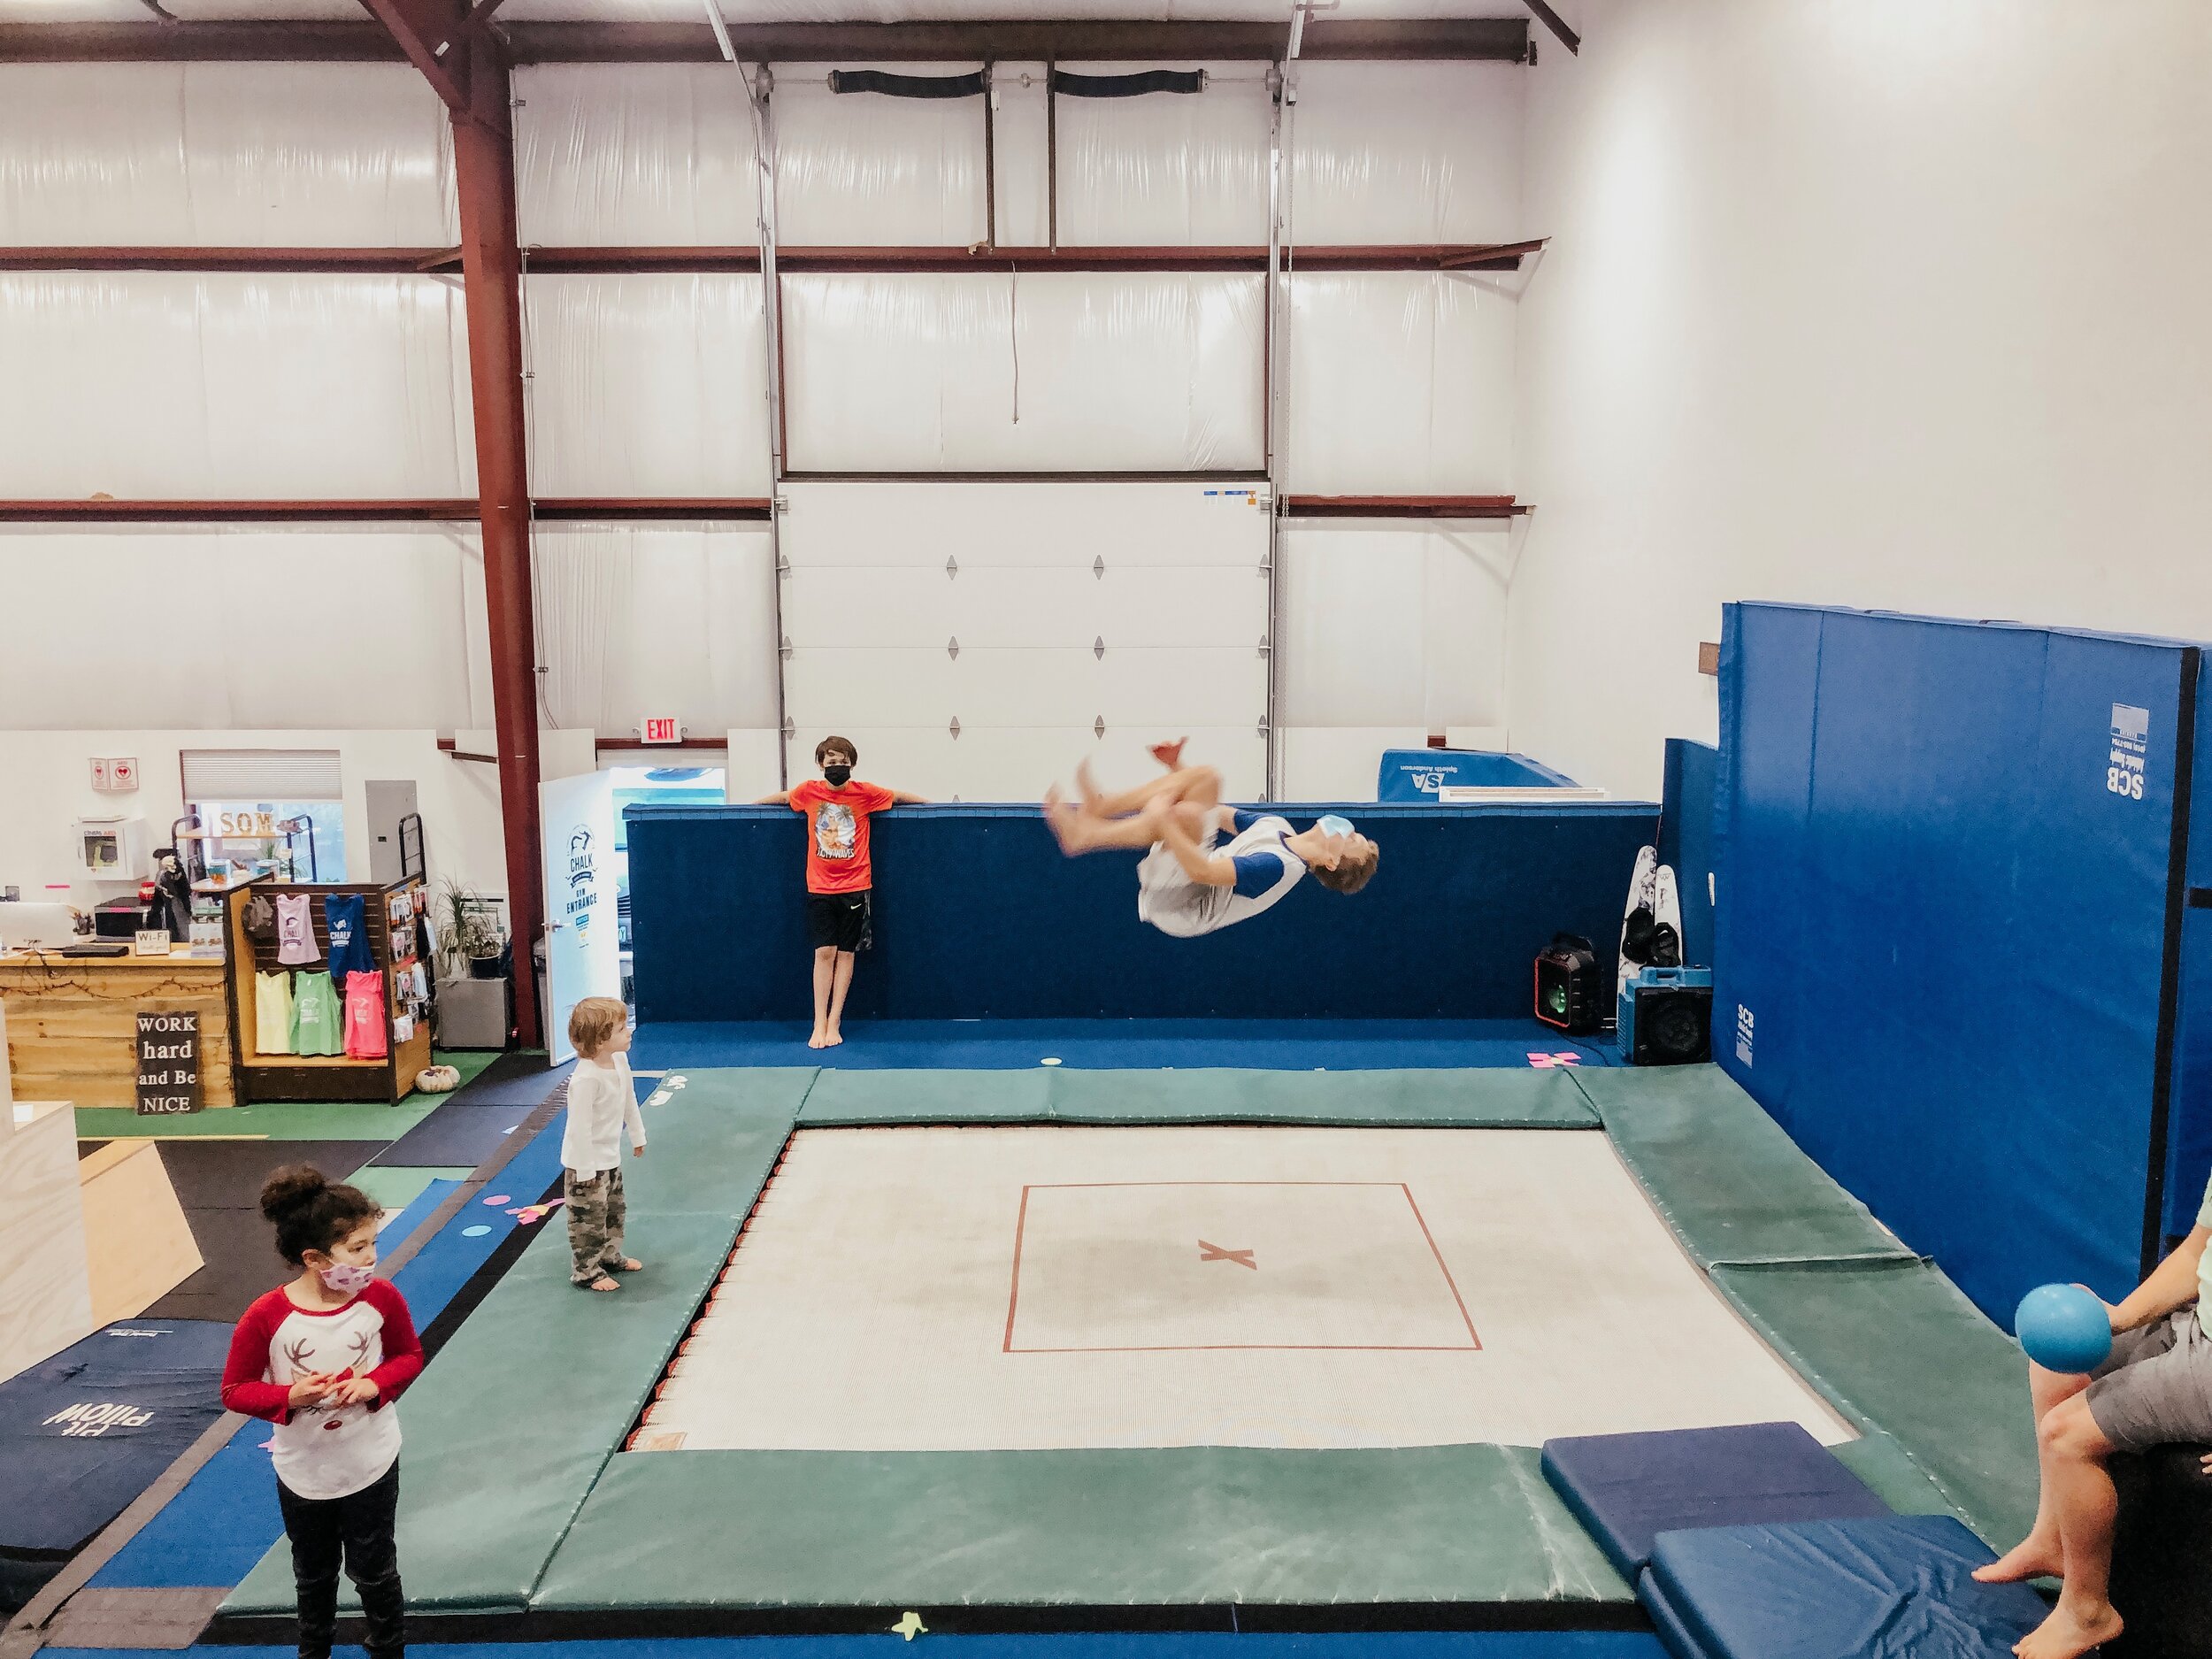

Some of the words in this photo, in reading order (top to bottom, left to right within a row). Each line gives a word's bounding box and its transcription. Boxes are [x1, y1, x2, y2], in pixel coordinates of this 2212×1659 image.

[647, 718, 674, 740] EXIT
[1411, 773, 1442, 791] SA
[2107, 767, 2144, 800] SCB
[219, 812, 273, 833] SOM
[570, 853, 594, 872] CHALK
[566, 893, 597, 915] ENTRANCE
[329, 931, 351, 940] CHALK
[137, 1017, 196, 1032] WORK
[1738, 1003, 1754, 1028] SCB
[142, 1040, 193, 1059] hard
[139, 1071, 168, 1085] and
[173, 1070, 196, 1085] Be
[143, 1097, 191, 1112] NICE
[61, 1421, 110, 1437] Pit
